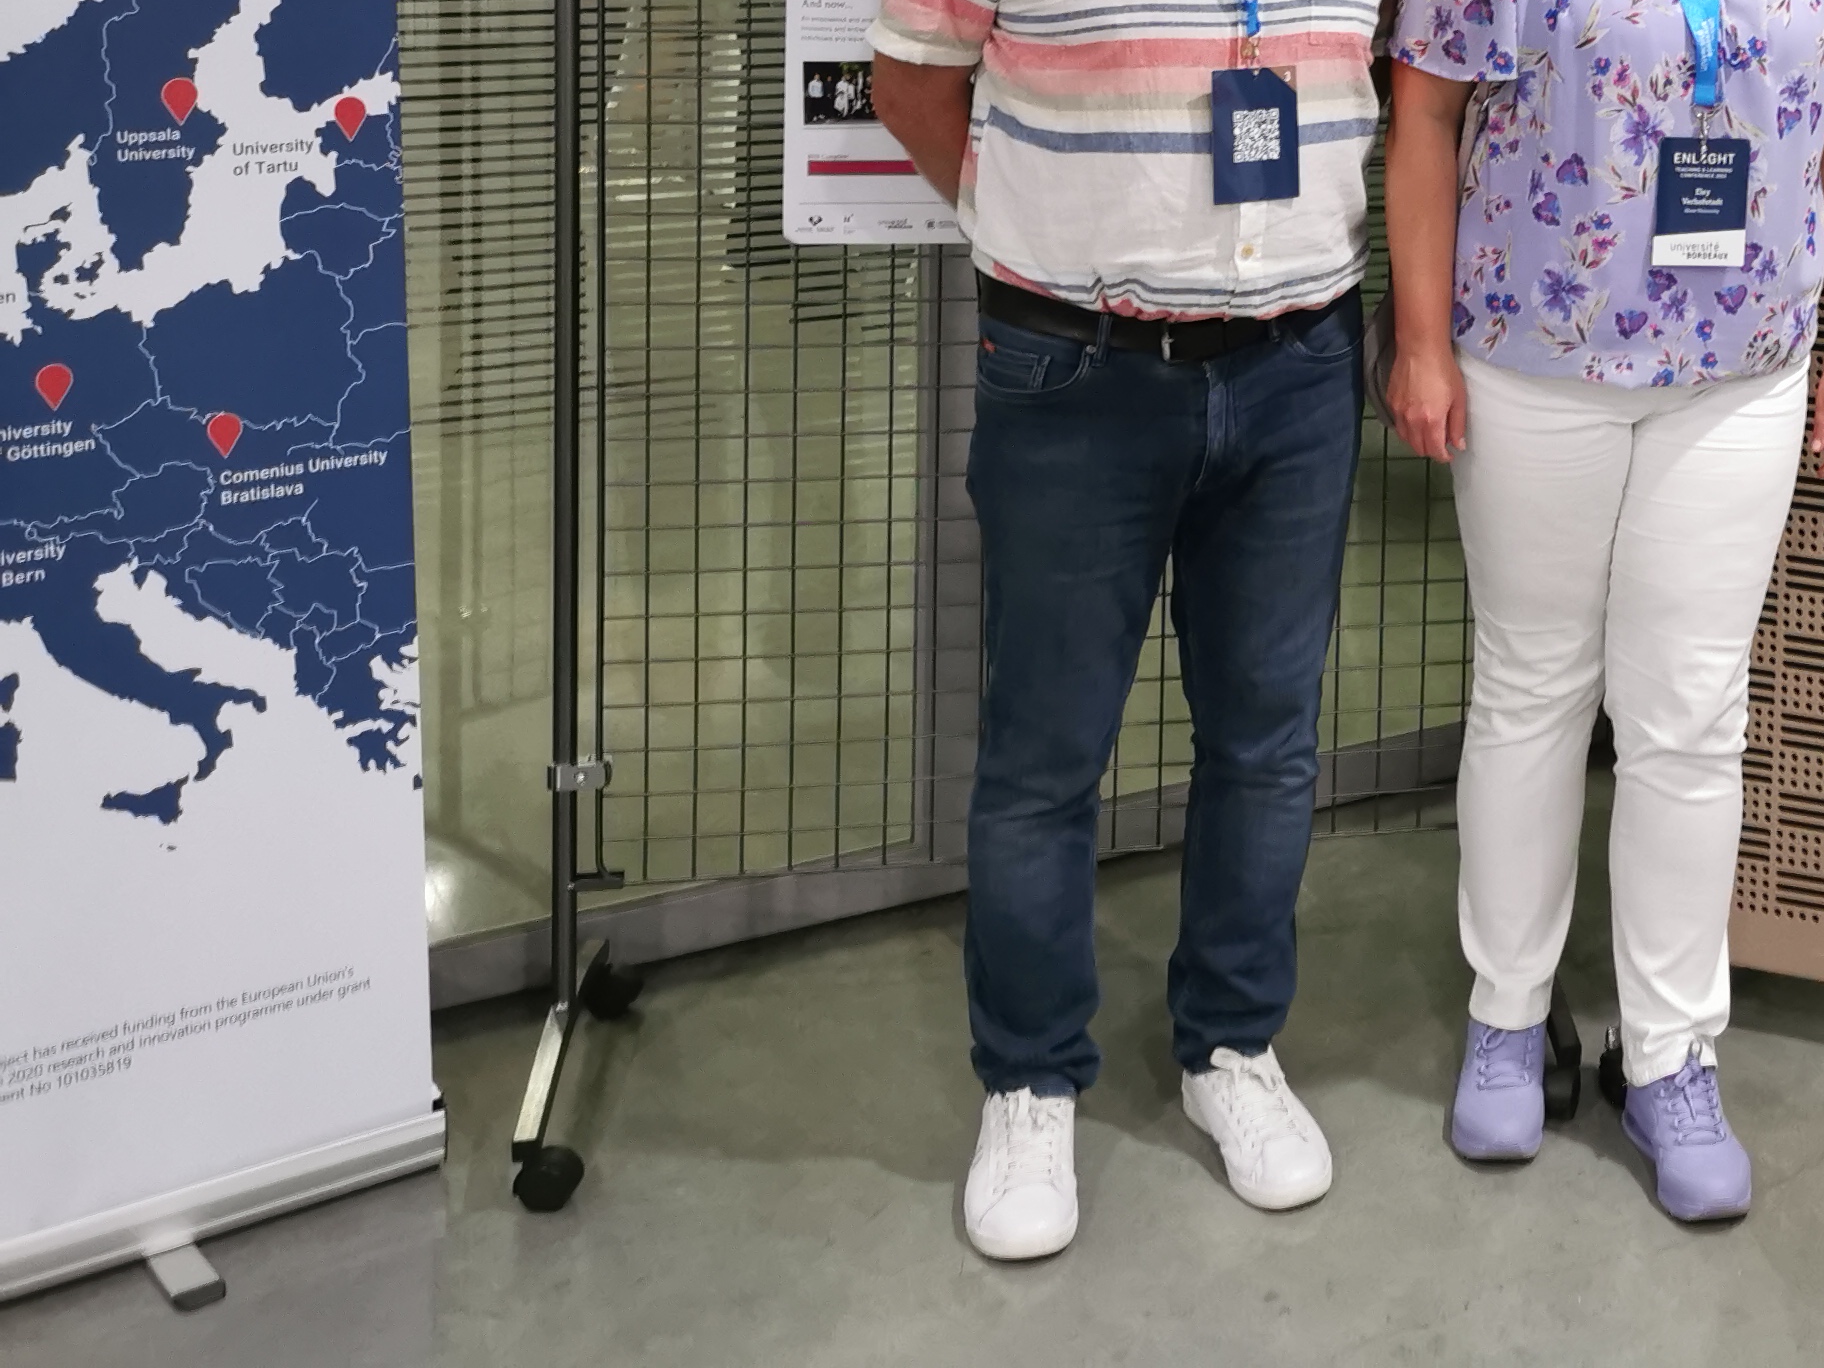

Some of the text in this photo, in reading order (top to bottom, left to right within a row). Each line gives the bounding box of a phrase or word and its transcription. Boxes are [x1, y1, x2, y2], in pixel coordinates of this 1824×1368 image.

[802, 0, 823, 9] And
[116, 128, 181, 145] Uppsala
[117, 145, 195, 162] University
[233, 138, 314, 156] University
[233, 159, 299, 177] of Tartu
[7, 437, 96, 462] Göttingen
[219, 450, 388, 486] Comenius University
[220, 482, 304, 506] Bratislava
[2, 568, 46, 588] Bern
[33, 965, 354, 1061] has received funding from the European Union's
[8, 1064, 43, 1085] 2020
[47, 1046, 105, 1073] research
[109, 1038, 135, 1056] and
[139, 1019, 211, 1048] innovation
[215, 999, 293, 1032] programme
[296, 989, 333, 1006] under
[337, 977, 371, 1001] grant
